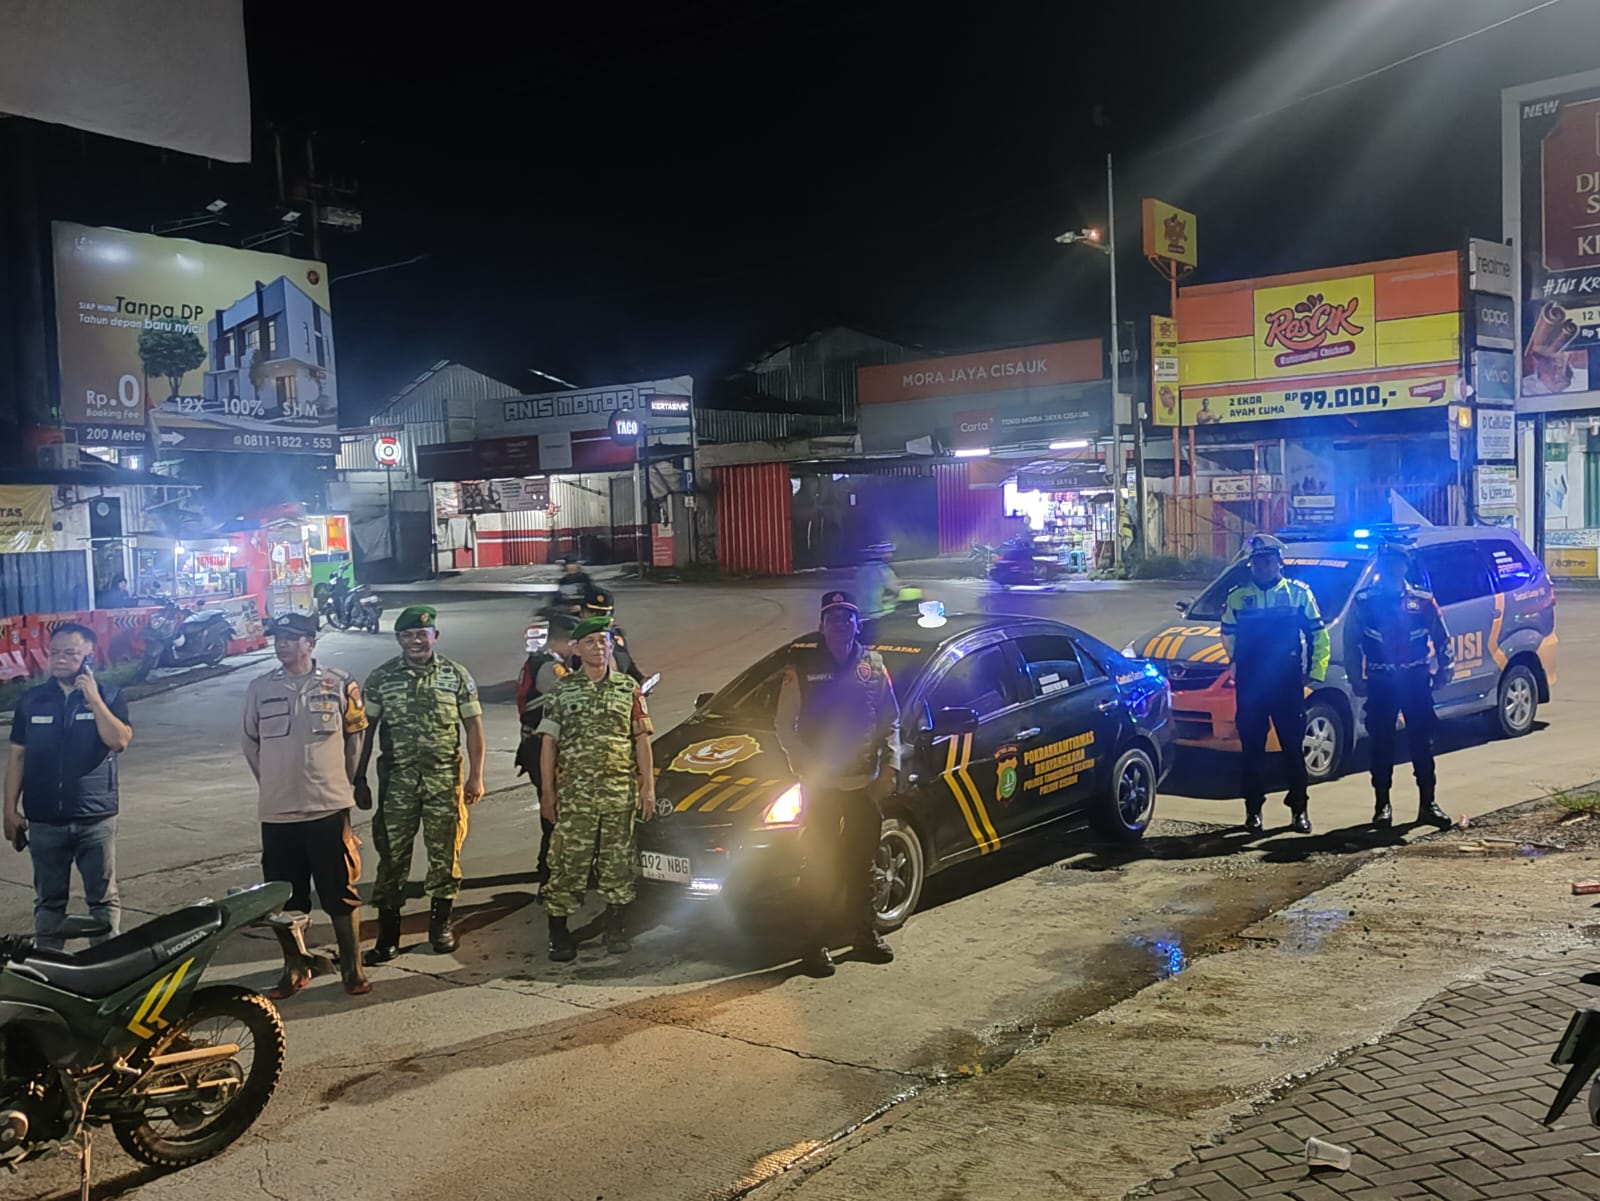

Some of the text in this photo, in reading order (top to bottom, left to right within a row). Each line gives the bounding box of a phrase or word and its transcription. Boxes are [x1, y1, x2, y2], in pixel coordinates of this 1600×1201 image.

[1523, 101, 1559, 118] NEW
[1477, 256, 1511, 277] realme
[115, 296, 174, 319] Tanpa
[181, 304, 203, 321] DP
[1481, 308, 1509, 325] oppo
[79, 313, 108, 326] Tahun
[111, 316, 141, 329] depan
[144, 318, 172, 331] baru
[902, 359, 1047, 387] MORA JAYA CISAUK
[1485, 369, 1509, 383] vivo
[222, 398, 265, 416] 100%
[503, 397, 555, 421] ANIS
[557, 388, 634, 416] MOTOR
[1237, 396, 1262, 405] EKOR
[1284, 392, 1299, 402] RP
[86, 408, 140, 419] Booking Fee
[1229, 405, 1285, 417] AYAM CUMA
[86, 428, 109, 440] 200
[615, 420, 638, 435] TACO
[960, 421, 989, 433] Carta
[312, 437, 333, 449] 553
[667, 857, 689, 874] NBG
[167, 930, 208, 957] HONDA
